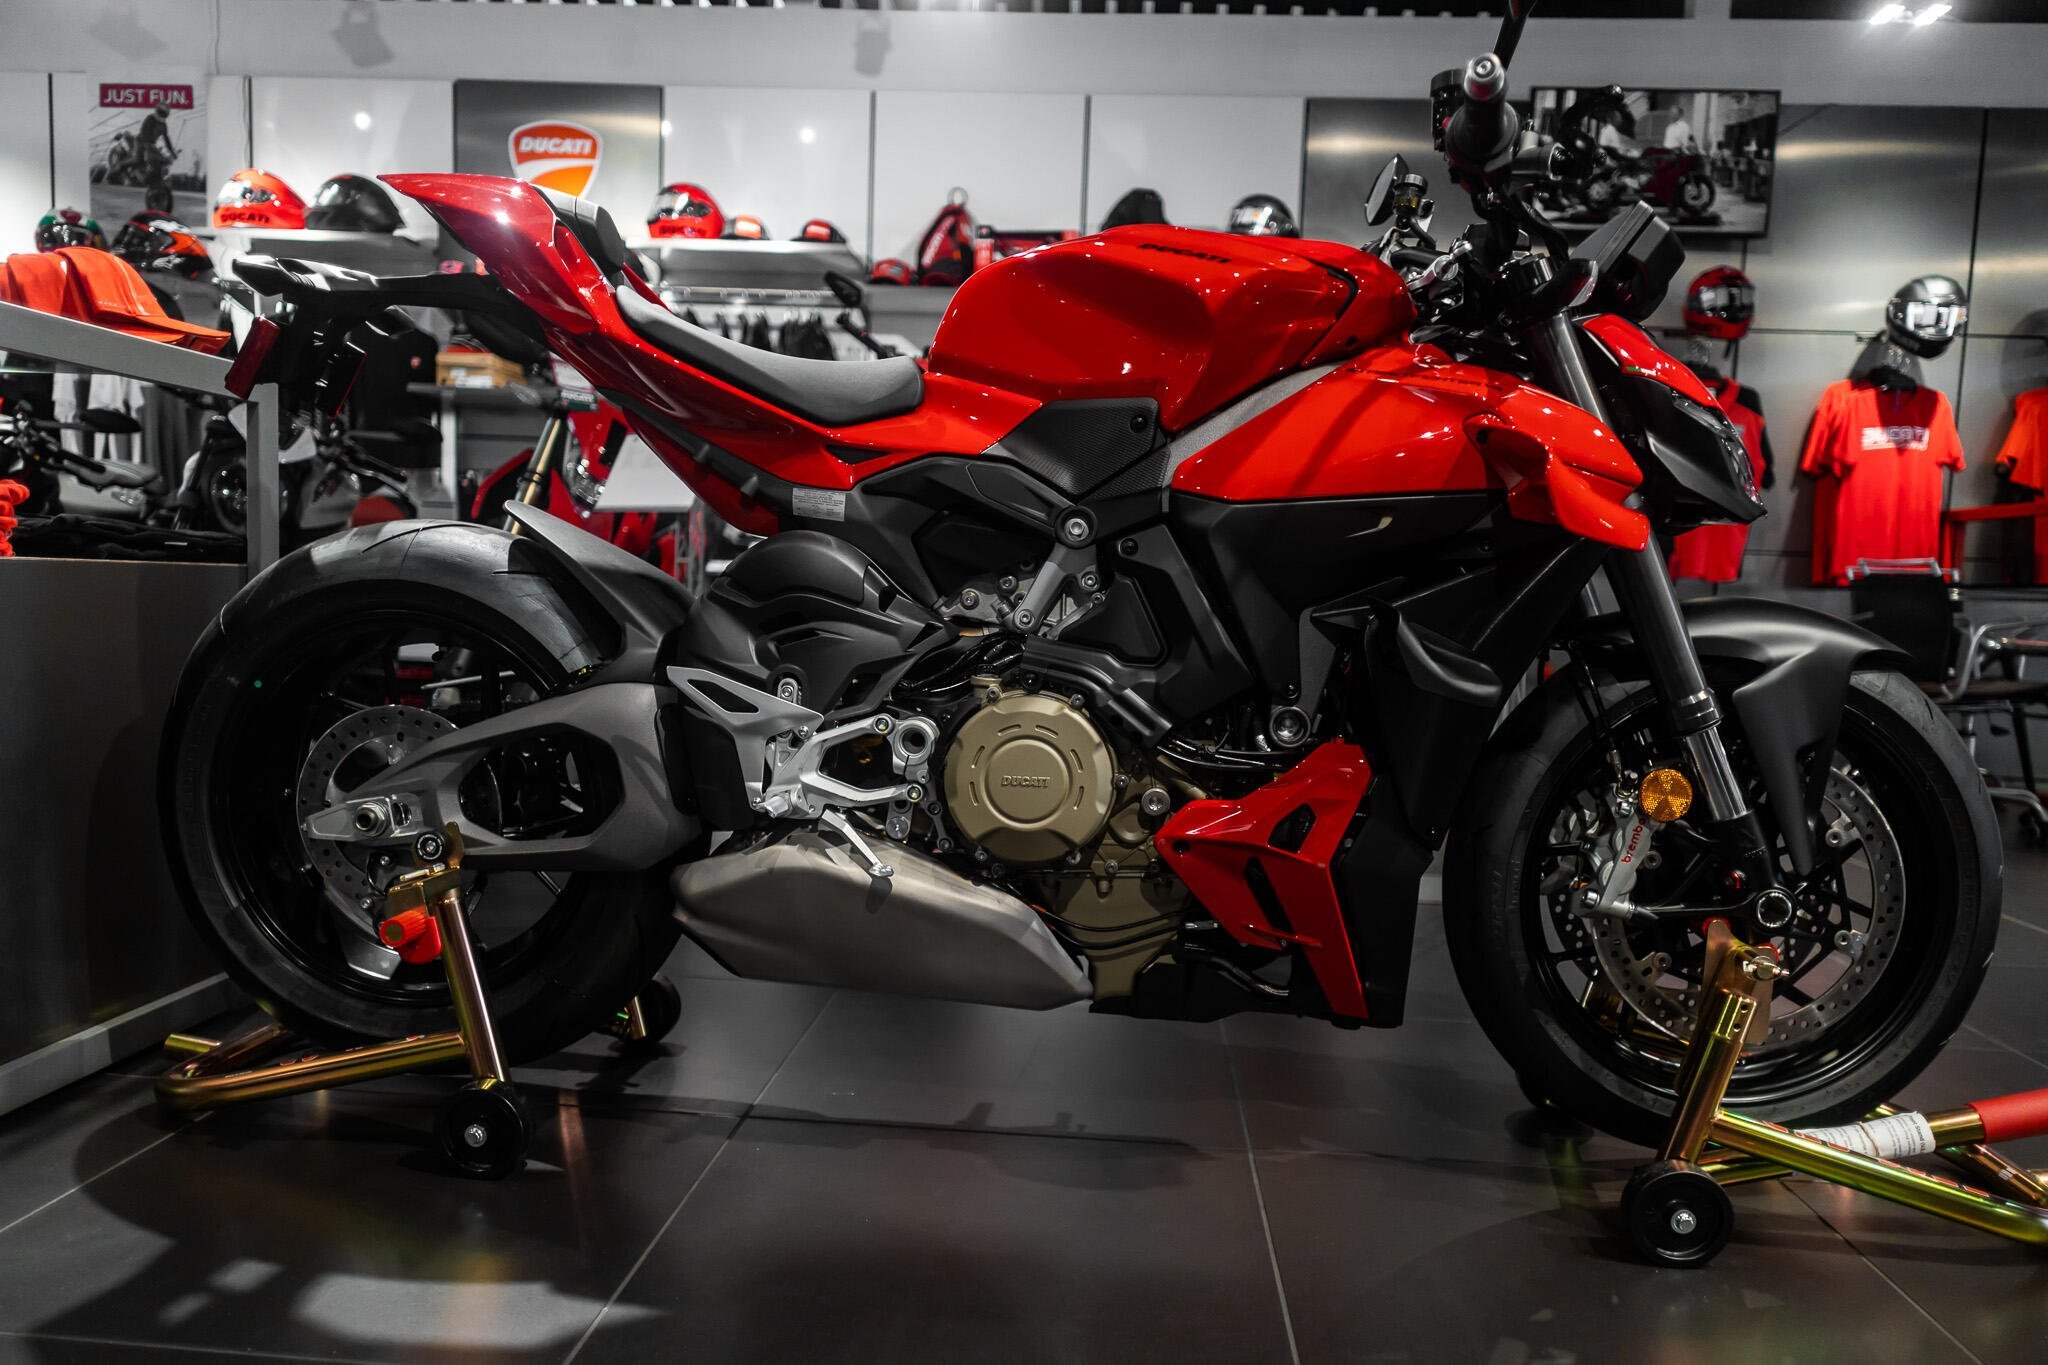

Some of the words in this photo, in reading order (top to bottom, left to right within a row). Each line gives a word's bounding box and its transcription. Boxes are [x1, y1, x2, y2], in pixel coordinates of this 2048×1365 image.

[104, 88, 146, 104] JUST
[519, 136, 593, 155] DUCATI
[220, 212, 271, 224] DUCATI
[1001, 775, 1051, 788] DUCATI
[1619, 816, 1646, 864] brembo
